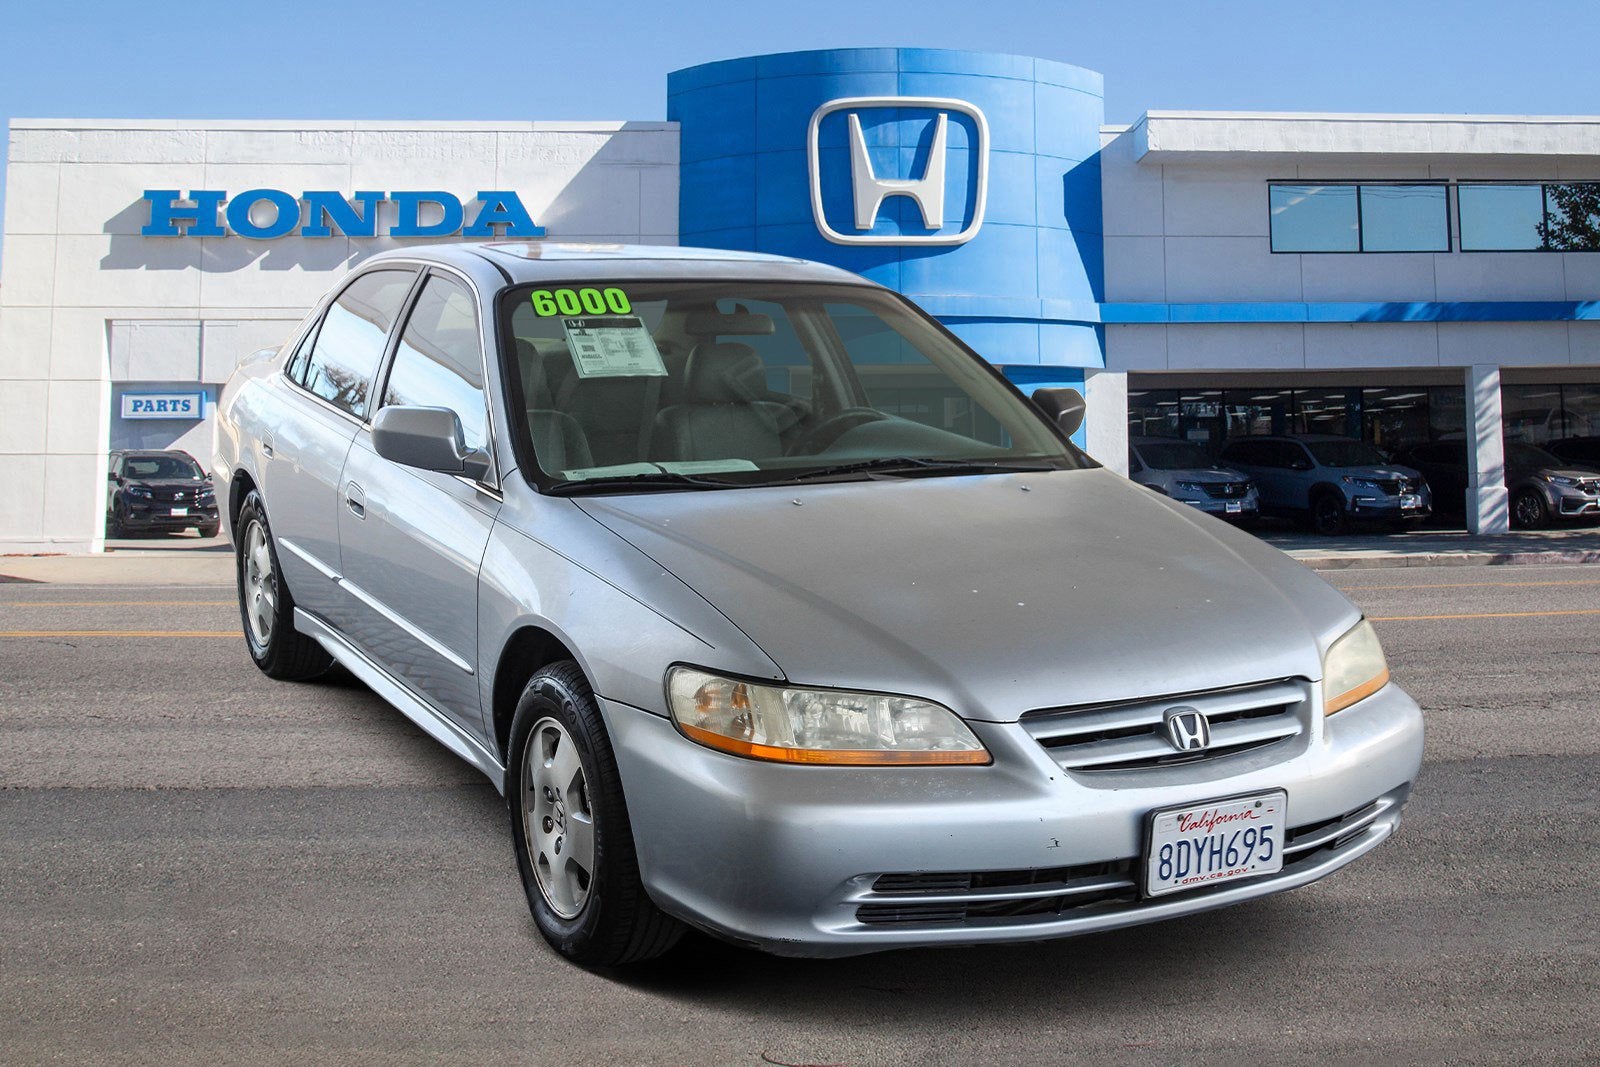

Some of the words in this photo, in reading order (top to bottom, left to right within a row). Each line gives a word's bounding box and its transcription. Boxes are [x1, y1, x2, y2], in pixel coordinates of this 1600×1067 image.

[143, 189, 546, 239] HONDA
[531, 287, 632, 317] 6000
[131, 399, 192, 413] PARTS
[1179, 805, 1260, 834] California
[1159, 825, 1273, 881] 8DYH695
[1181, 866, 1249, 886] dmv.ca.gov
